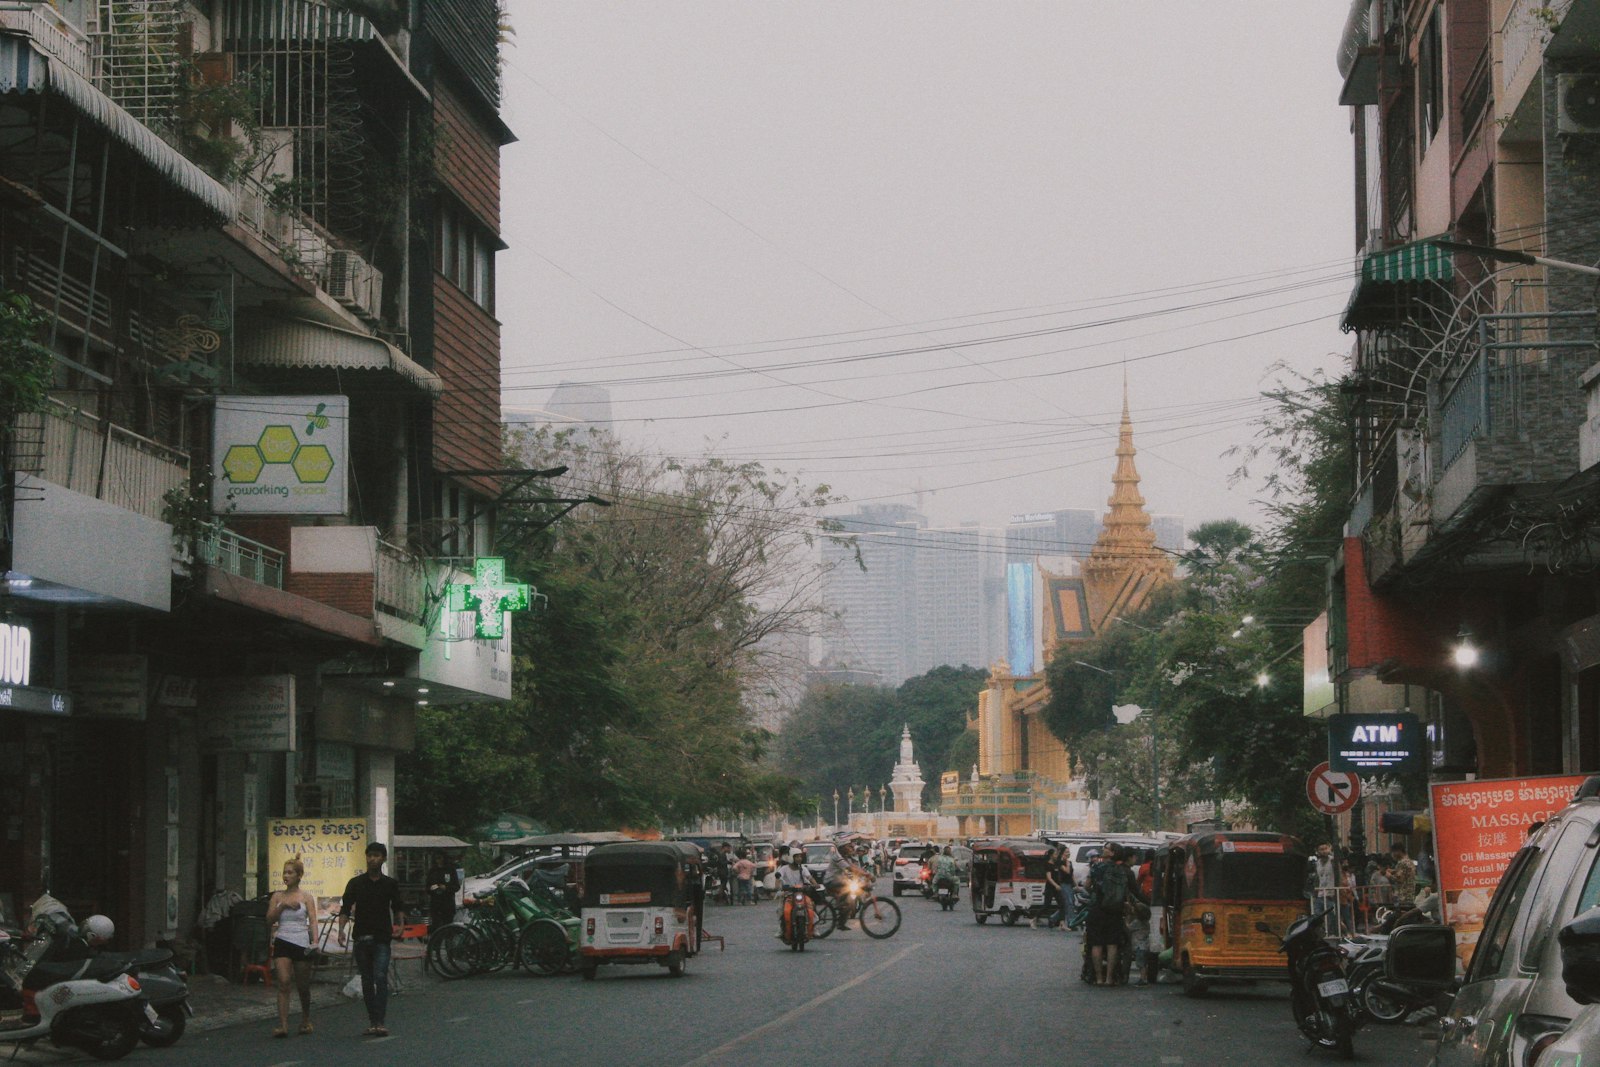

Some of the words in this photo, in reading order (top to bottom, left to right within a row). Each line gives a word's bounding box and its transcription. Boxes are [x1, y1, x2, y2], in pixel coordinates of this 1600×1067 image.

[228, 484, 289, 497] coworking
[1351, 725, 1398, 742] ATM
[284, 841, 354, 854] MASSAGE
[1461, 863, 1494, 874] Casual
[1463, 876, 1477, 886] Air
